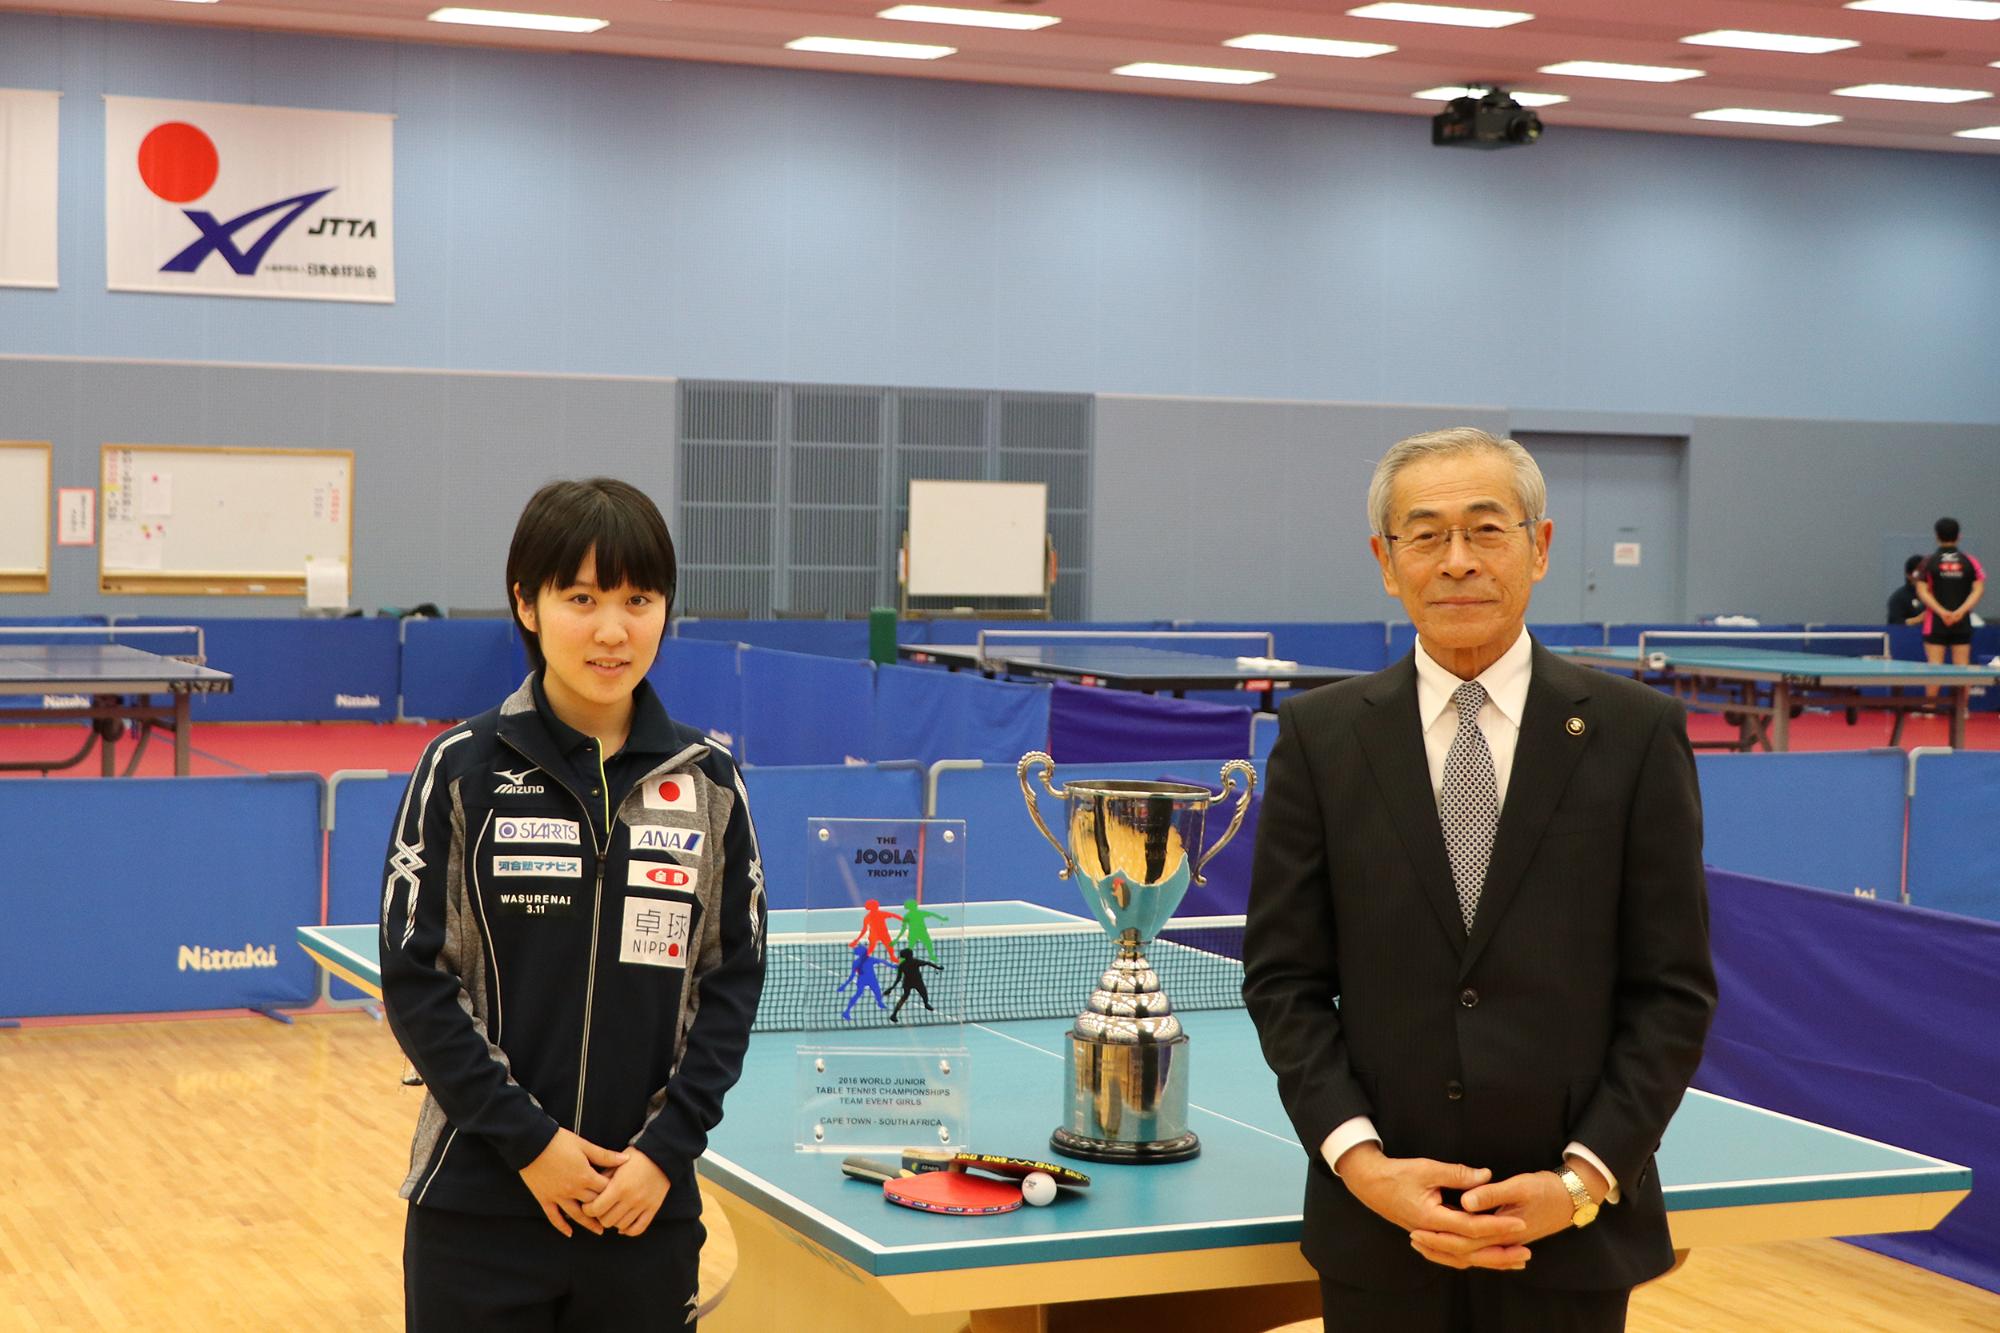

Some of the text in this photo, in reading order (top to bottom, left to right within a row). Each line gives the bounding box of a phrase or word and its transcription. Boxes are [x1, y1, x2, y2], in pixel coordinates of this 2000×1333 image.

[307, 218, 376, 237] JTTA
[520, 823, 578, 841] STARTS
[638, 830, 681, 849] ANA
[876, 837, 897, 845] THE
[855, 848, 917, 864] JOOLA
[867, 869, 909, 877] TROPHY
[500, 894, 572, 905] WASURENAI
[526, 905, 545, 914] 3.11
[635, 909, 688, 939] 卓球
[838, 1077, 857, 1085] 2016
[894, 1078, 926, 1086] JUNIOR
[816, 1086, 950, 1096] TABLE TENNIS CHAMPIONSHIPS
[840, 1097, 863, 1105] TEAM
[896, 1098, 922, 1106] GIRLS
[820, 1117, 844, 1125] CAPE
[845, 1117, 872, 1125] TOWN
[879, 1118, 909, 1126] SOUTH
